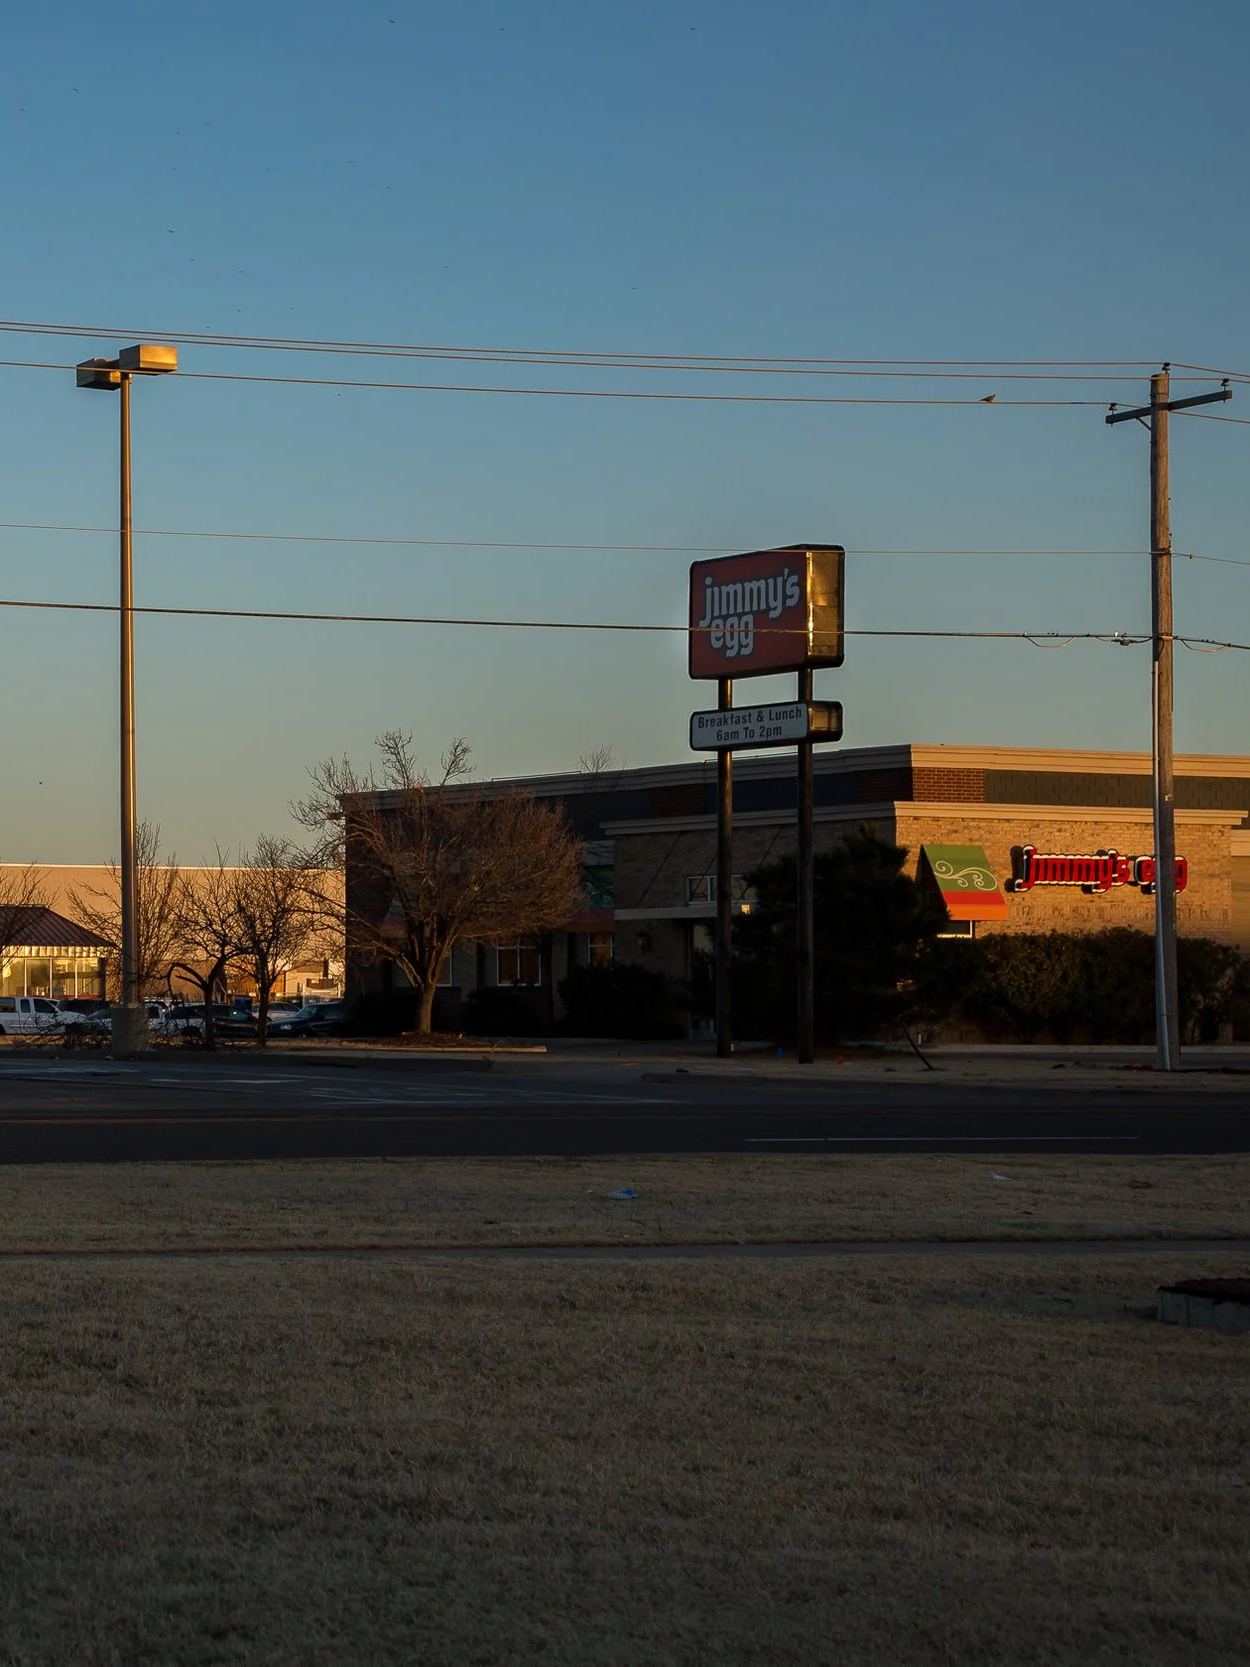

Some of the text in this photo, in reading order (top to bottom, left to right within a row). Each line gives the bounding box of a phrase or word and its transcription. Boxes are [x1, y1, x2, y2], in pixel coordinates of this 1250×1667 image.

[699, 568, 800, 627] jimmy's
[710, 614, 754, 658] egg
[698, 707, 802, 729] Breakfast & Lunch
[716, 724, 783, 742] 6am To 2pm
[1014, 845, 1188, 894] jimmy's eg
